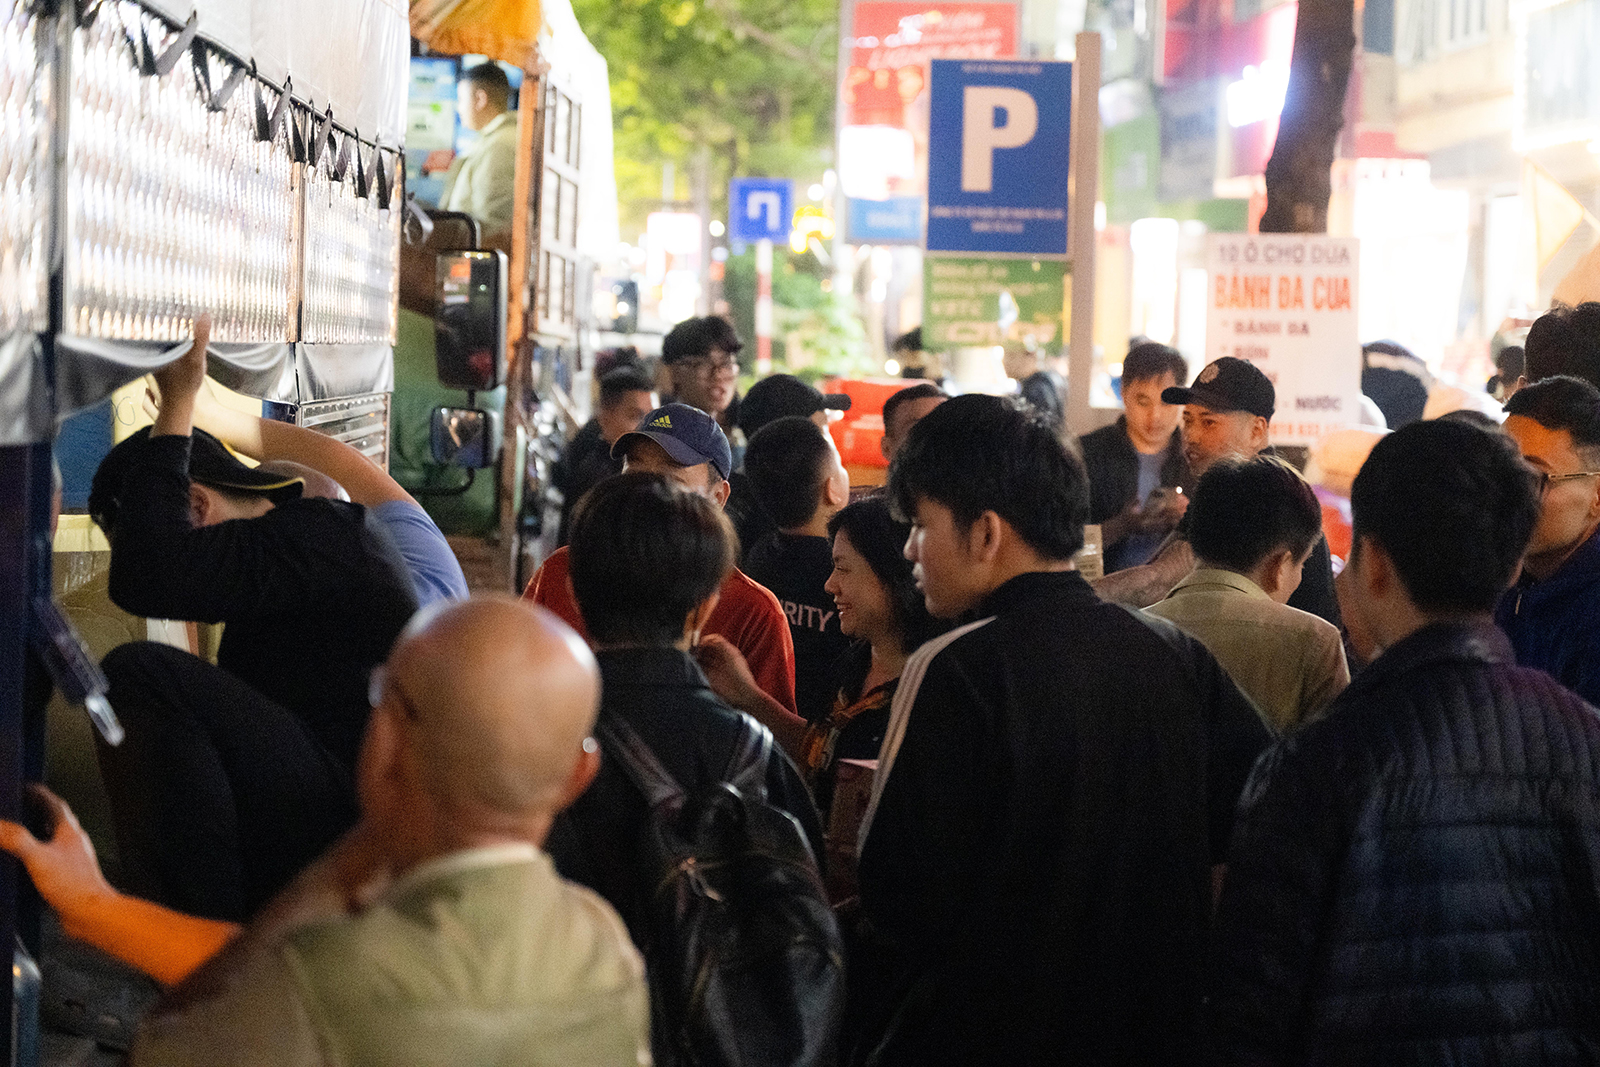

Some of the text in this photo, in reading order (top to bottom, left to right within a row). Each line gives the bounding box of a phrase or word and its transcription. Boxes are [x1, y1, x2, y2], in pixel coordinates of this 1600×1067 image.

[961, 86, 1039, 192] P
[1312, 276, 1351, 311] CUA
[780, 599, 834, 632] RITY
